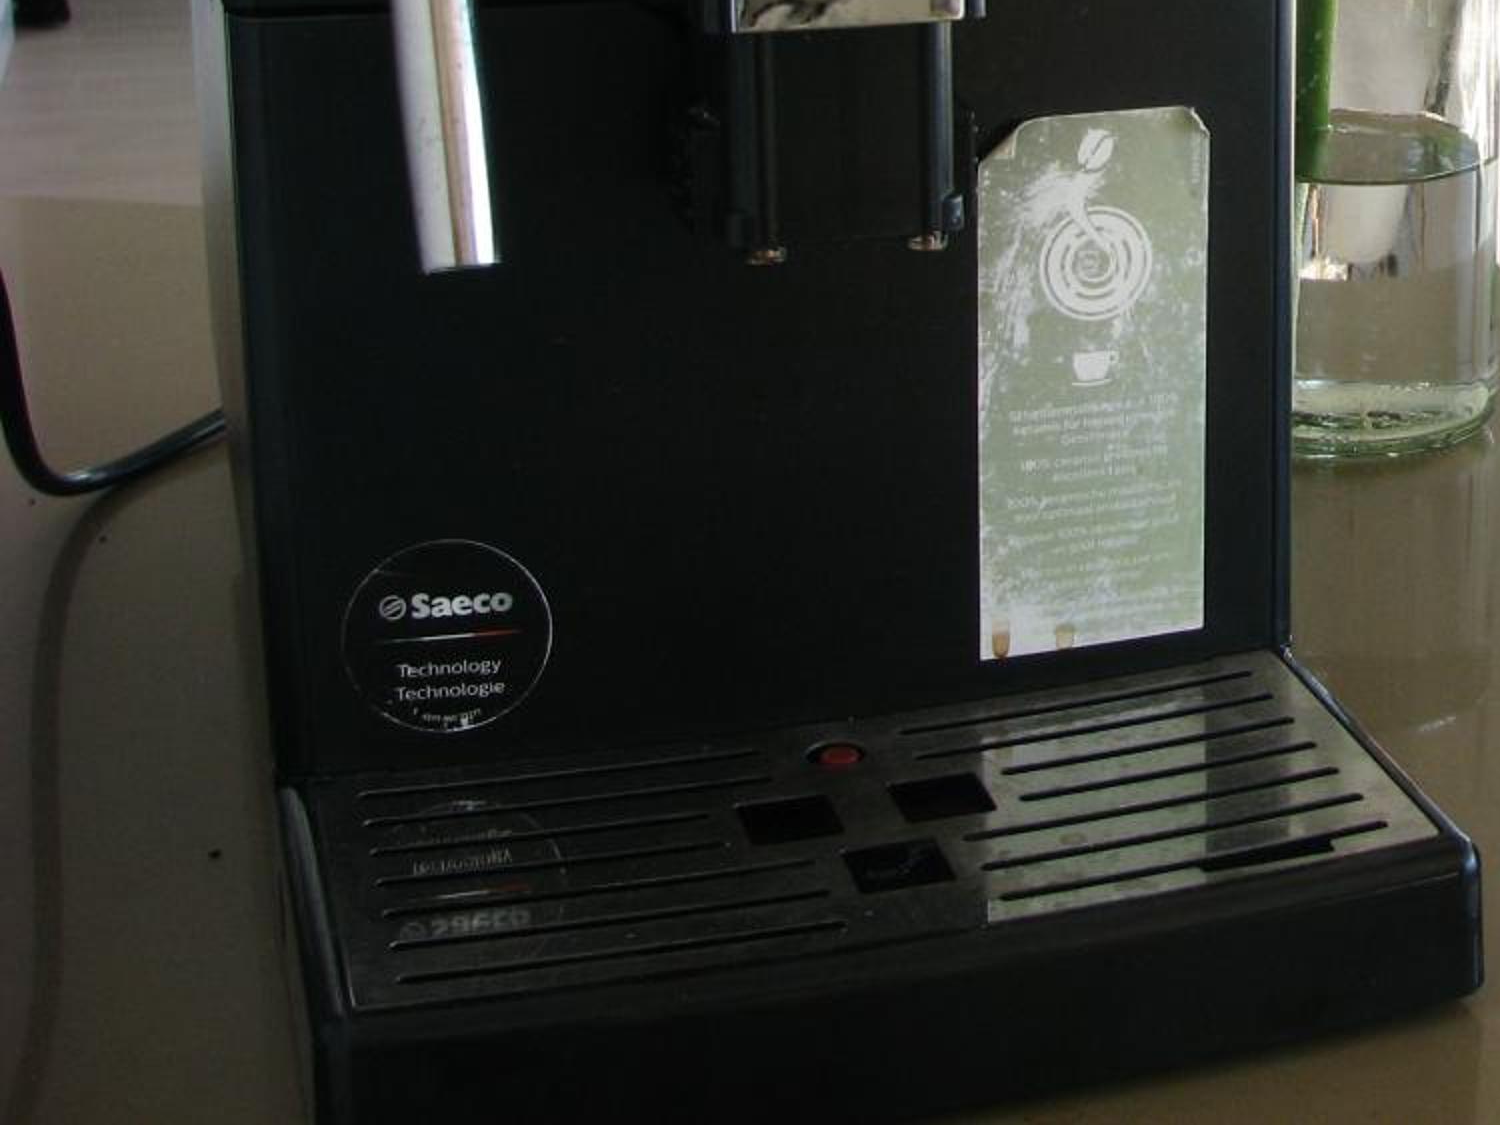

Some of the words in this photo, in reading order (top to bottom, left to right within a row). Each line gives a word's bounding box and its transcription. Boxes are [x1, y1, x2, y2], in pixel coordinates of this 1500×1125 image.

[411, 592, 514, 620] Saeco
[395, 658, 502, 679] Technology
[394, 681, 506, 702] Technologie
